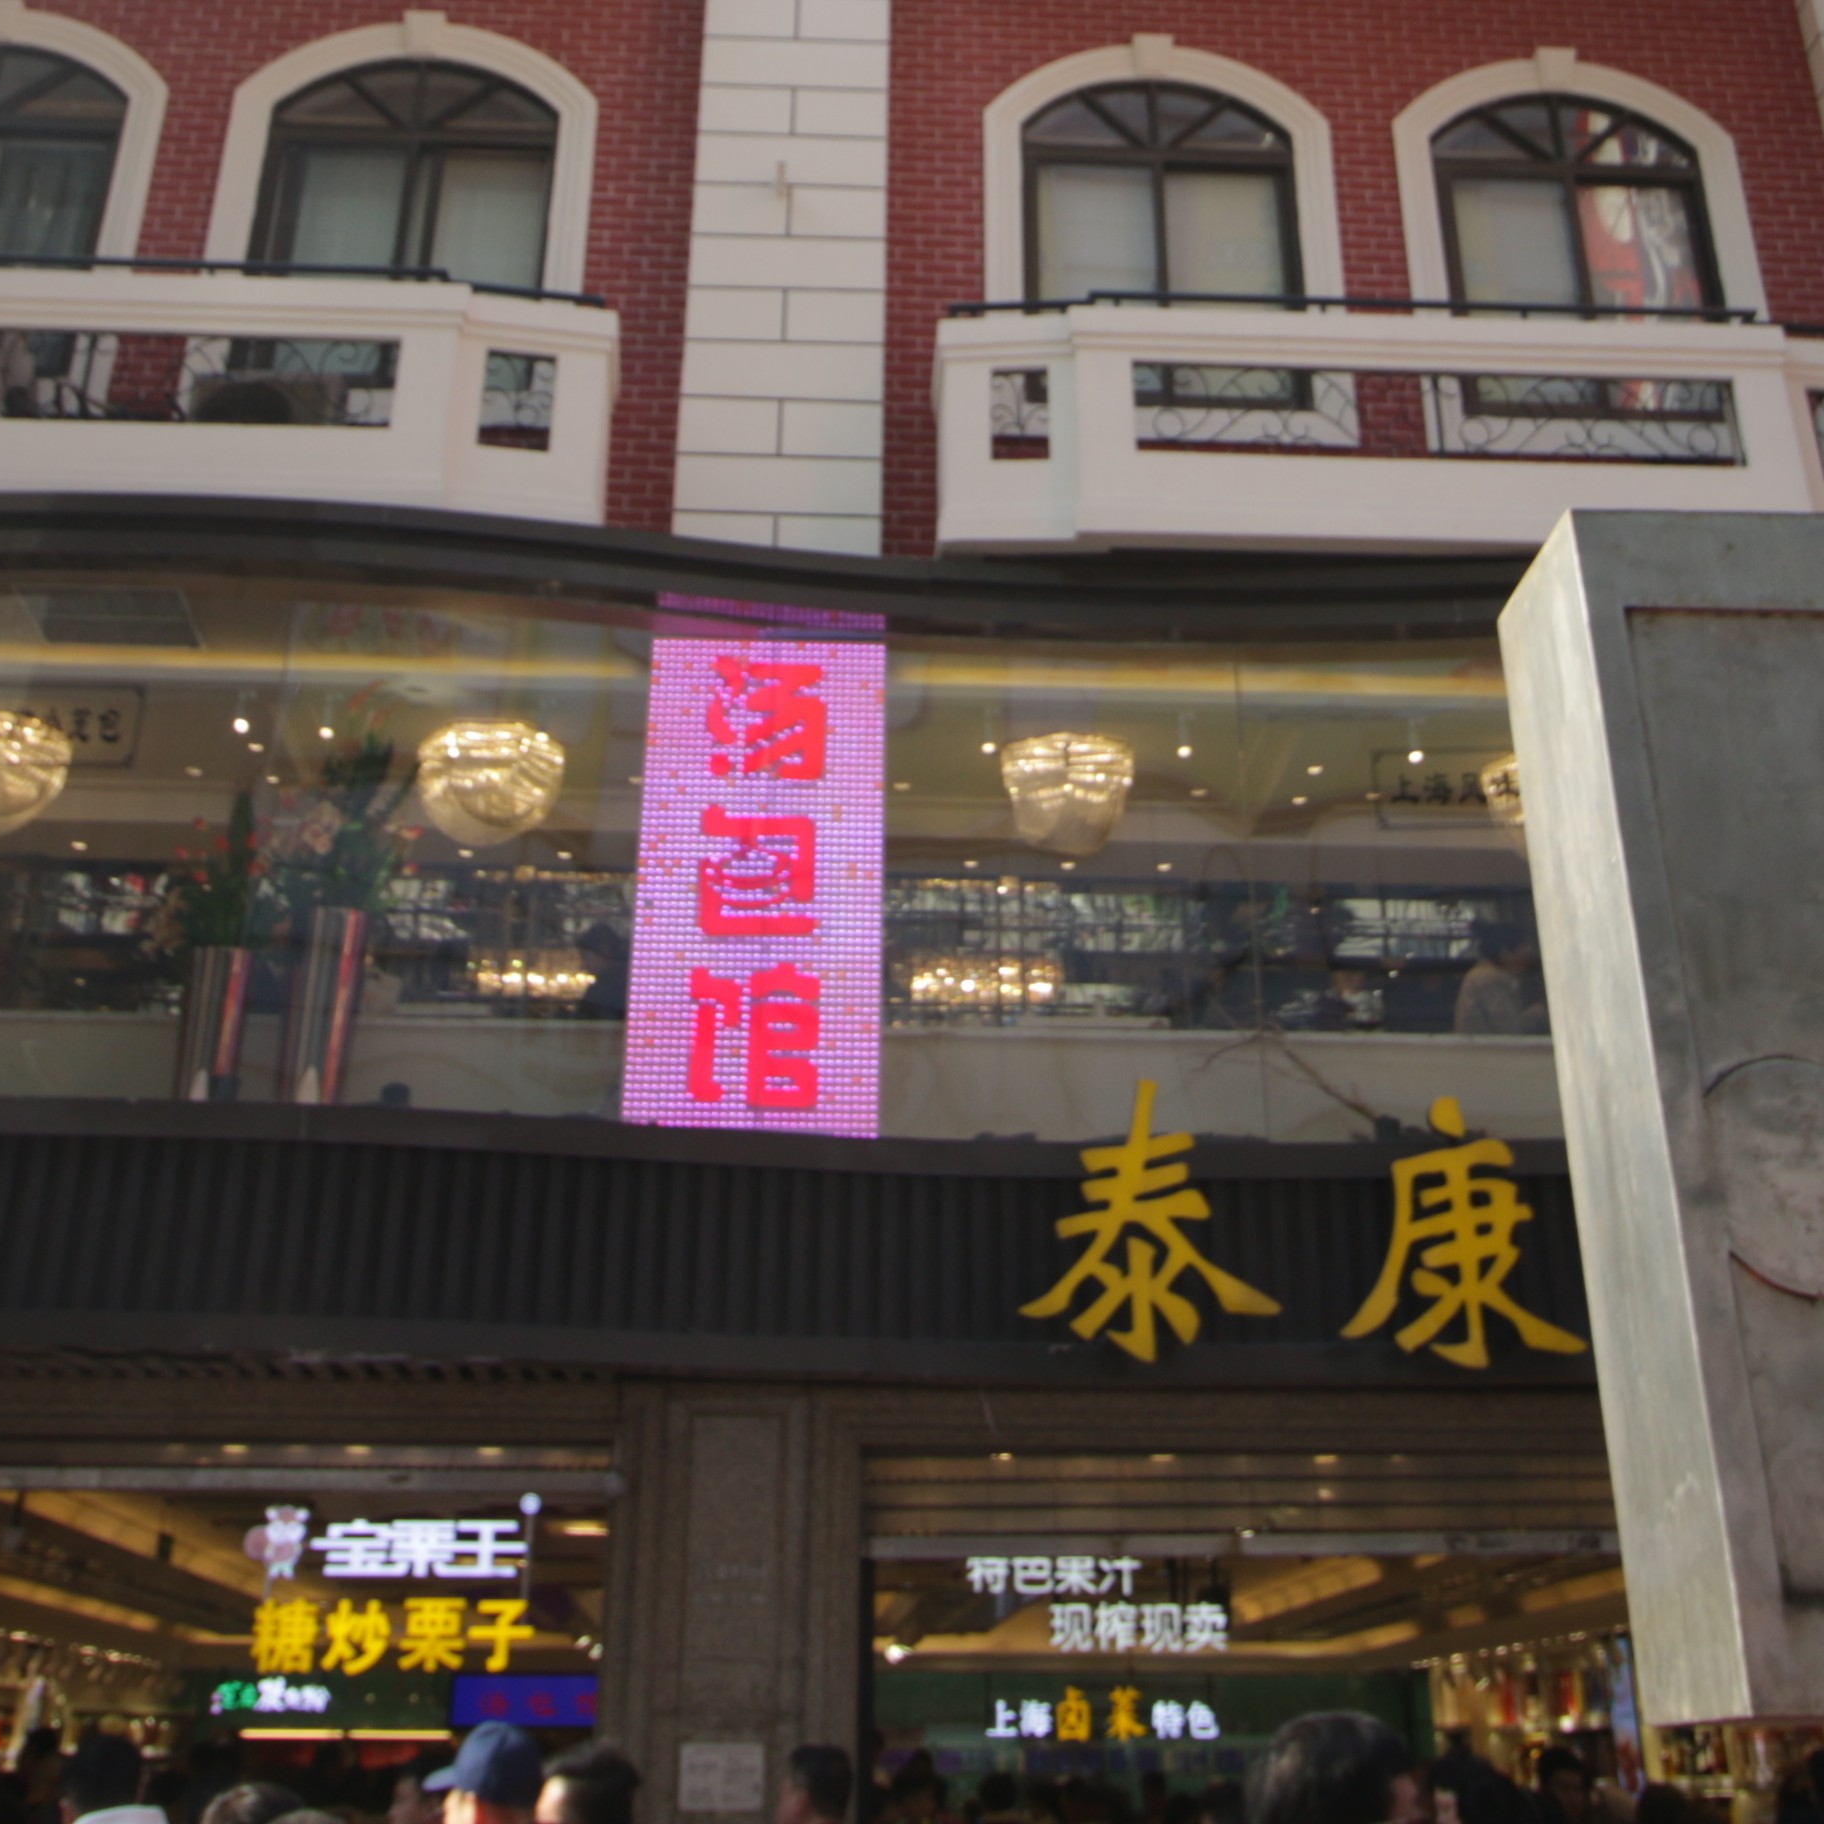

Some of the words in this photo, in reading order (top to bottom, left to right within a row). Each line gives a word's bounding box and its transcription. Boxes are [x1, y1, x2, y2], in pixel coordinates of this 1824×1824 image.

[684, 654, 828, 1111] 汤包馆
[1017, 1078, 1587, 1369] 泰康
[250, 1597, 536, 1677] 糖炒栗子
[1048, 1600, 1230, 1655] 现榨现卖
